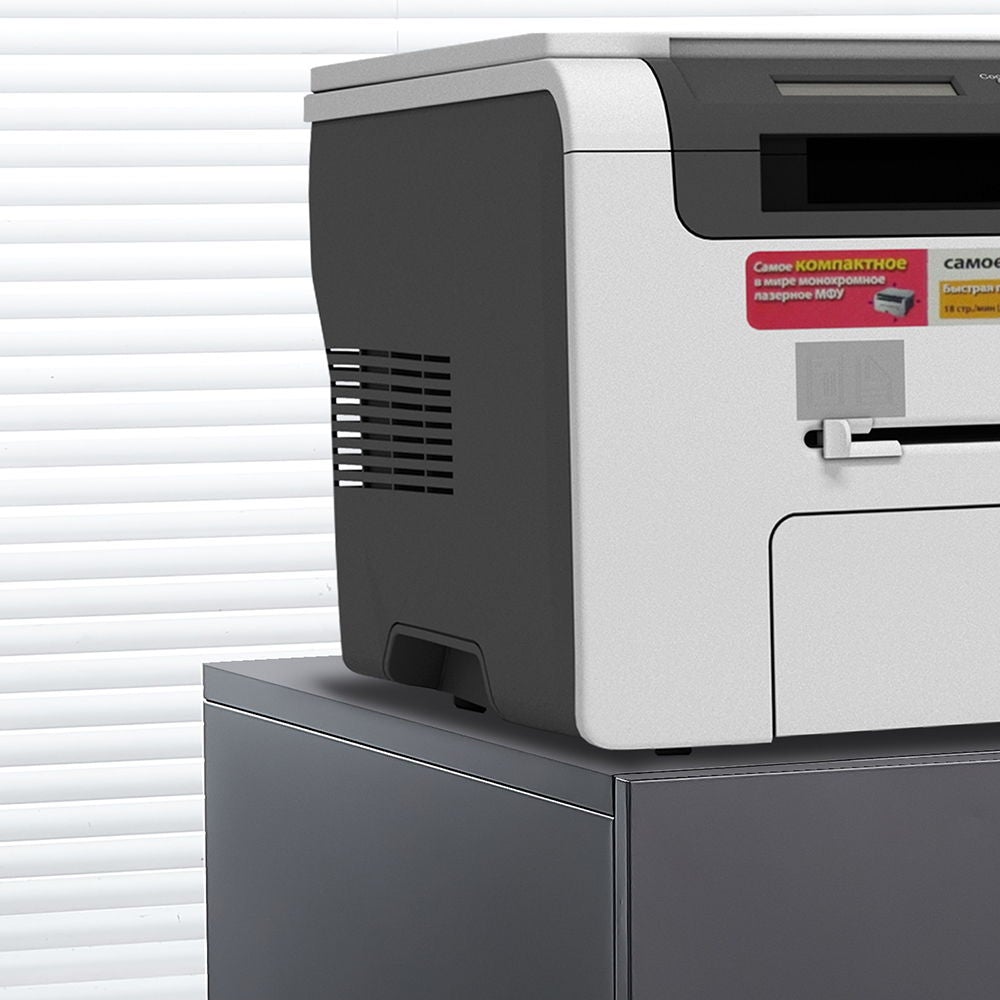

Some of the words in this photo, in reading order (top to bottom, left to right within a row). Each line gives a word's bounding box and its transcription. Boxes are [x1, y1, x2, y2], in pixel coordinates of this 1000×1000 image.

[753, 261, 793, 273] Самое
[795, 257, 908, 273] компактное
[764, 277, 796, 289] мире
[798, 273, 887, 288] монохромное
[754, 290, 812, 303] лазерное
[815, 289, 845, 300] МФУ
[943, 283, 993, 297] Быстрая
[944, 305, 954, 314] 18
